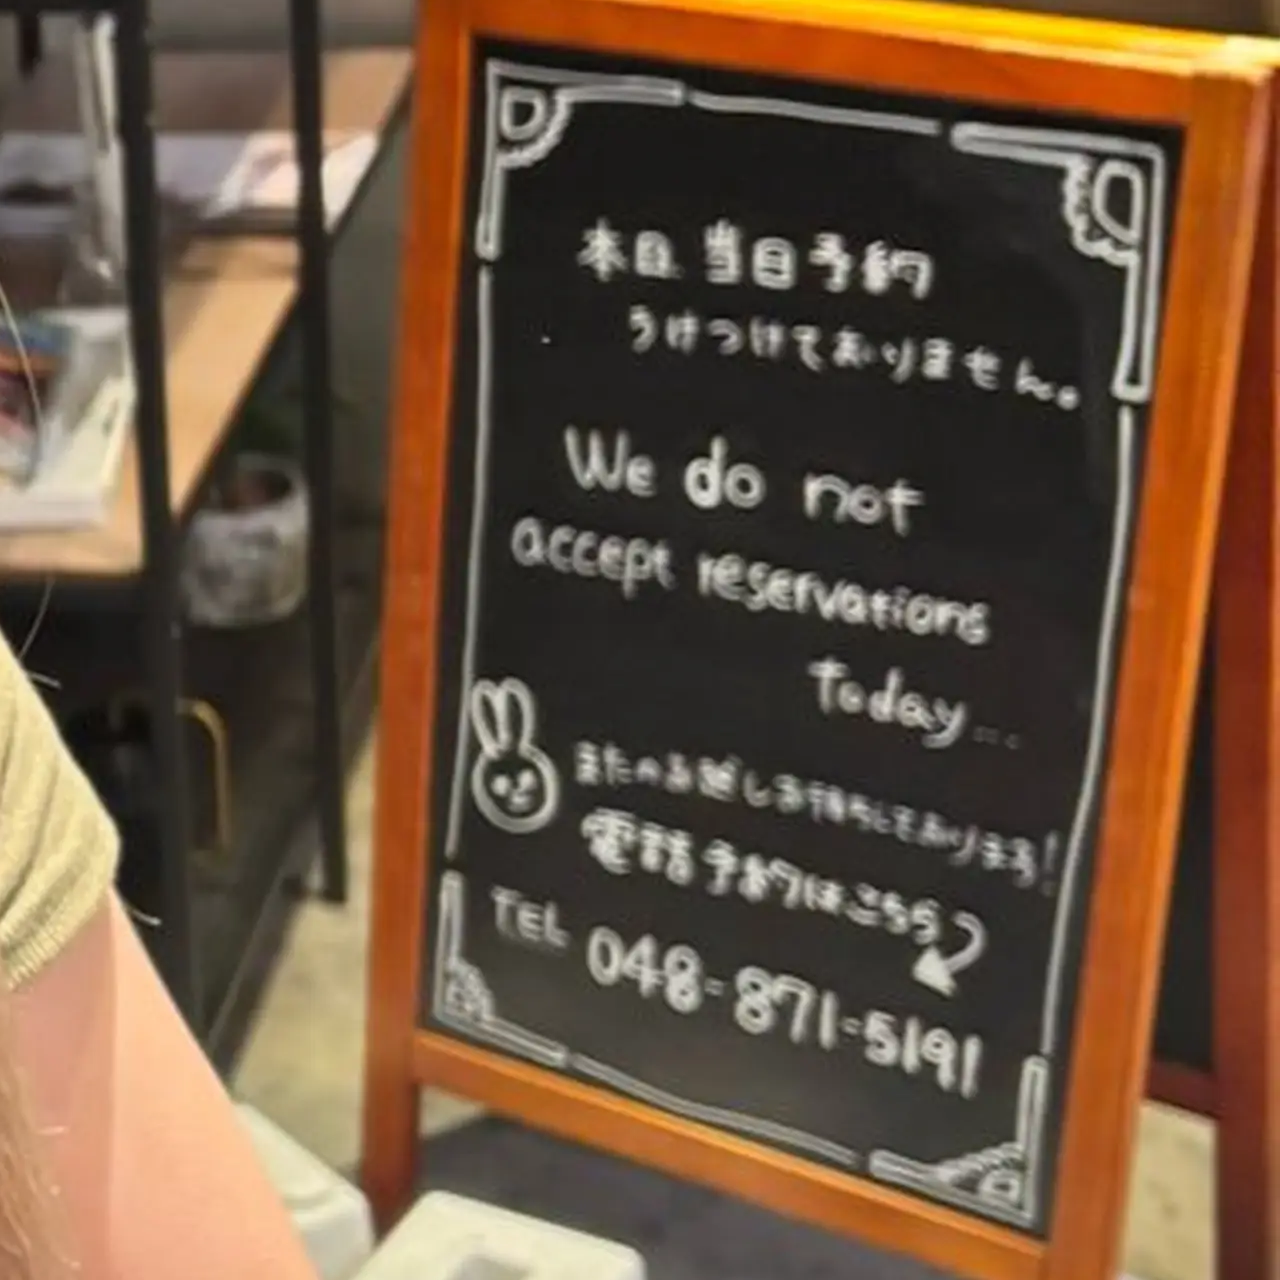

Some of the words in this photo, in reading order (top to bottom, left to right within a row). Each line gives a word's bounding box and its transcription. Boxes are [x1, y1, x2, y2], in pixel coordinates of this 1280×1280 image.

[564, 425, 657, 497] We
[683, 434, 767, 508] do
[802, 471, 925, 536] not
[511, 516, 676, 598] accept
[697, 551, 992, 645] reservations
[491, 885, 570, 952] TEL
[586, 926, 983, 1099] 048-871-5191
